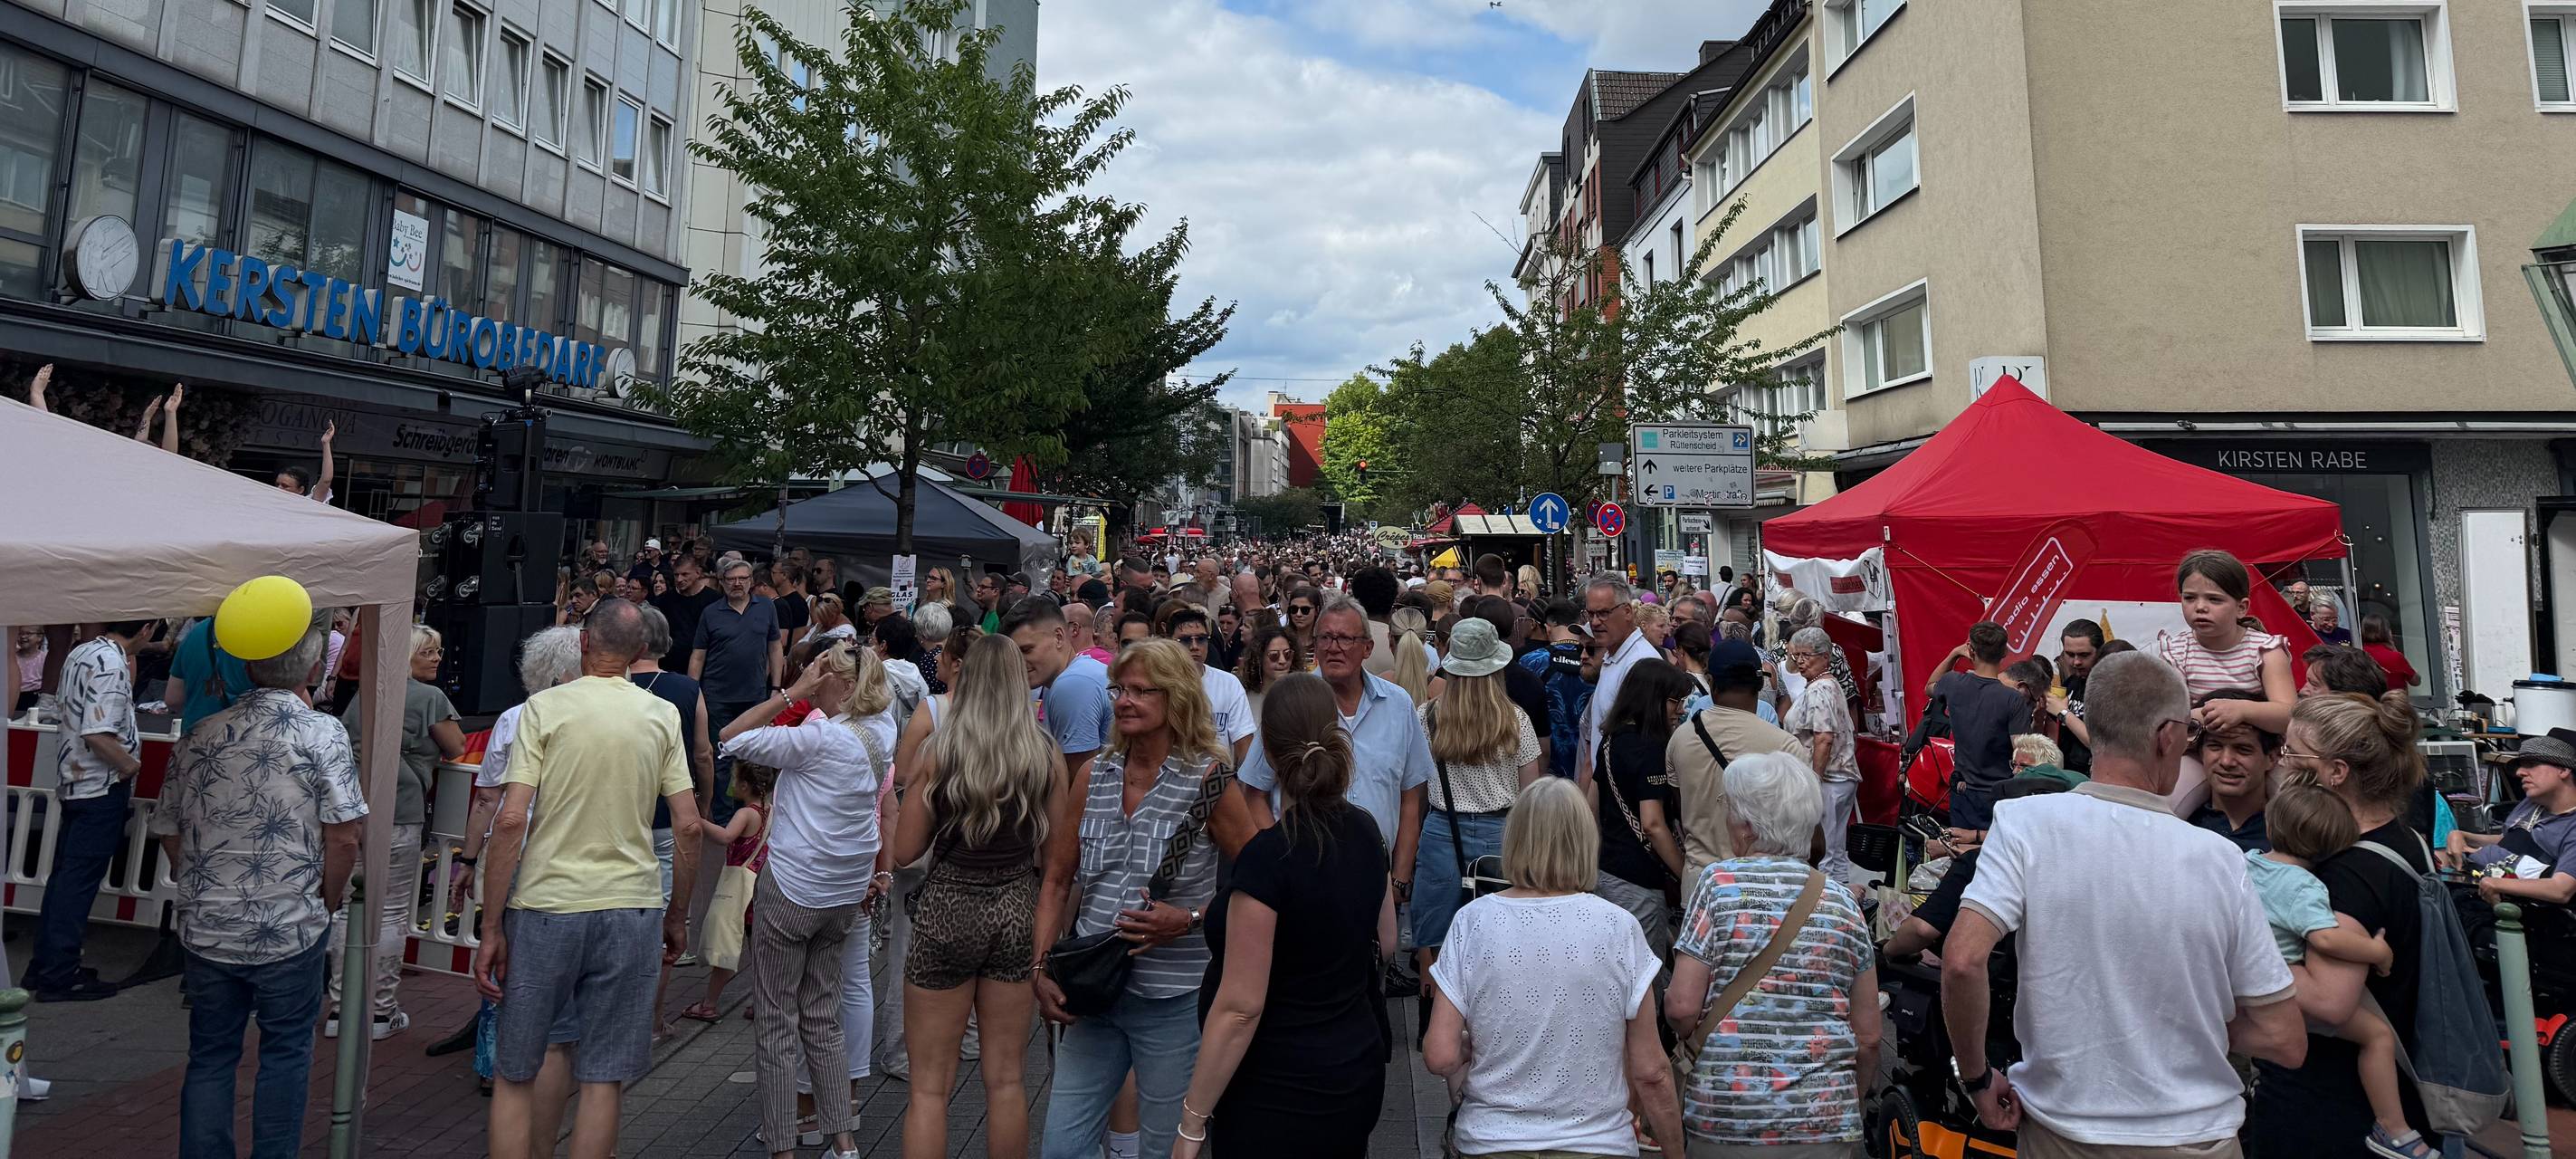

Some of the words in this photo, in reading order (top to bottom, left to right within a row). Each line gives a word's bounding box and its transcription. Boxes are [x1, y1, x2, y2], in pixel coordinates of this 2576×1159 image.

[410, 225, 423, 238] Bee
[165, 239, 382, 345] KERSTEN
[398, 297, 606, 388] BÜROBEDARF
[393, 423, 478, 456] Schreibgerä
[1663, 429, 1723, 441] Parkleitsystem
[1670, 441, 1716, 450] Rüttenscheid
[543, 443, 569, 463] aren
[2218, 450, 2302, 468] KIRSTEN
[2311, 451, 2367, 469] RABE
[594, 453, 640, 470] MONTBLANC
[1673, 465, 1702, 473] weitere
[1704, 464, 1748, 474] Parkplätze
[1665, 486, 1674, 498] P
[1376, 531, 1409, 543] Crêpes
[2003, 596, 2028, 630] radio
[2031, 554, 2059, 594] essen
[1553, 656, 1581, 666] elless
